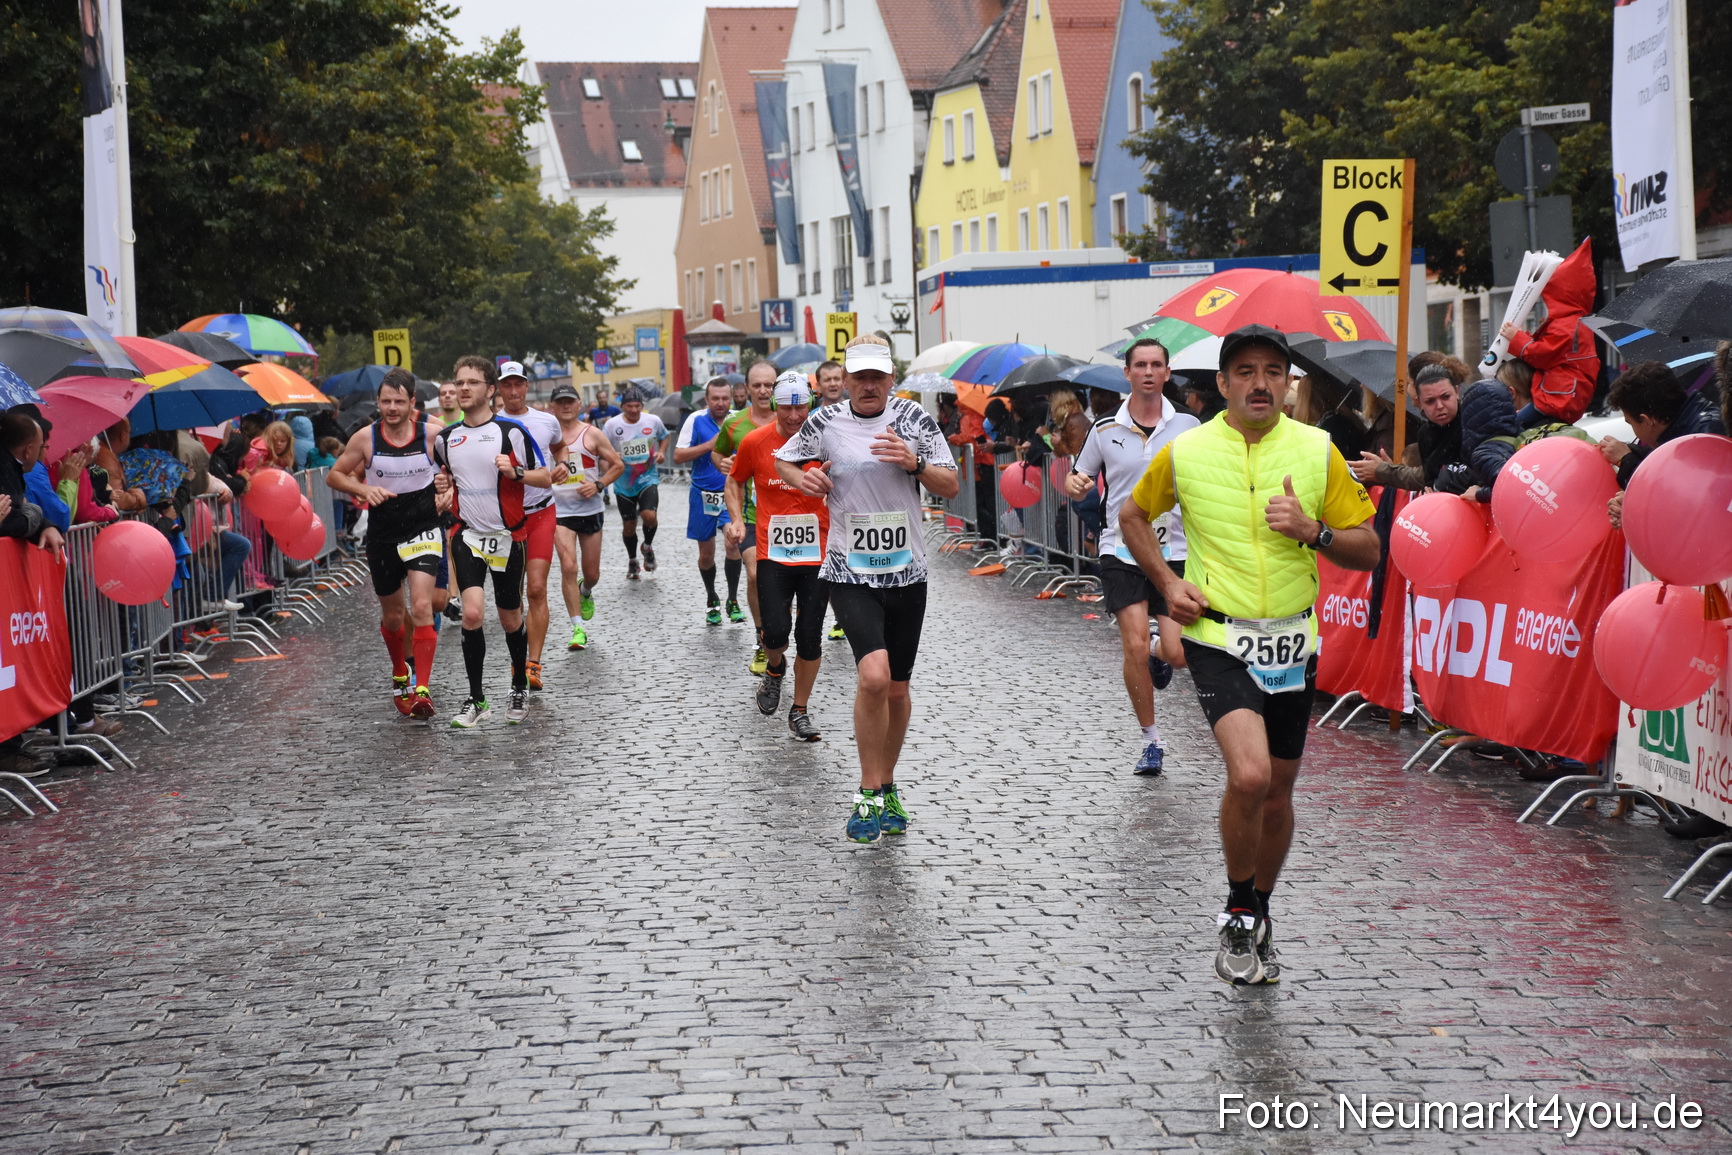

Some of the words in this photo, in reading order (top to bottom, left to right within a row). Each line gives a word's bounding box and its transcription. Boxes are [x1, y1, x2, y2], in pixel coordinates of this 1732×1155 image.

[1534, 110, 1559, 121] Ulmer
[1561, 108, 1586, 119] Gasse
[1333, 165, 1403, 190] Block
[955, 188, 978, 213] HOTEL
[1342, 200, 1390, 267] C
[829, 314, 854, 325] Block
[378, 331, 405, 342] Block
[834, 328, 850, 353] D
[384, 345, 402, 367] D
[623, 444, 647, 456] 2398
[1525, 489, 1554, 515] energie
[874, 513, 907, 524] BOCK
[773, 526, 816, 545] 2695
[853, 526, 907, 552] 2090
[412, 543, 432, 553] Flocke
[478, 537, 498, 554] 19
[785, 549, 804, 557] Peter
[869, 556, 891, 566] Erich
[1237, 633, 1306, 667] 2562
[1262, 673, 1287, 687] Josef
